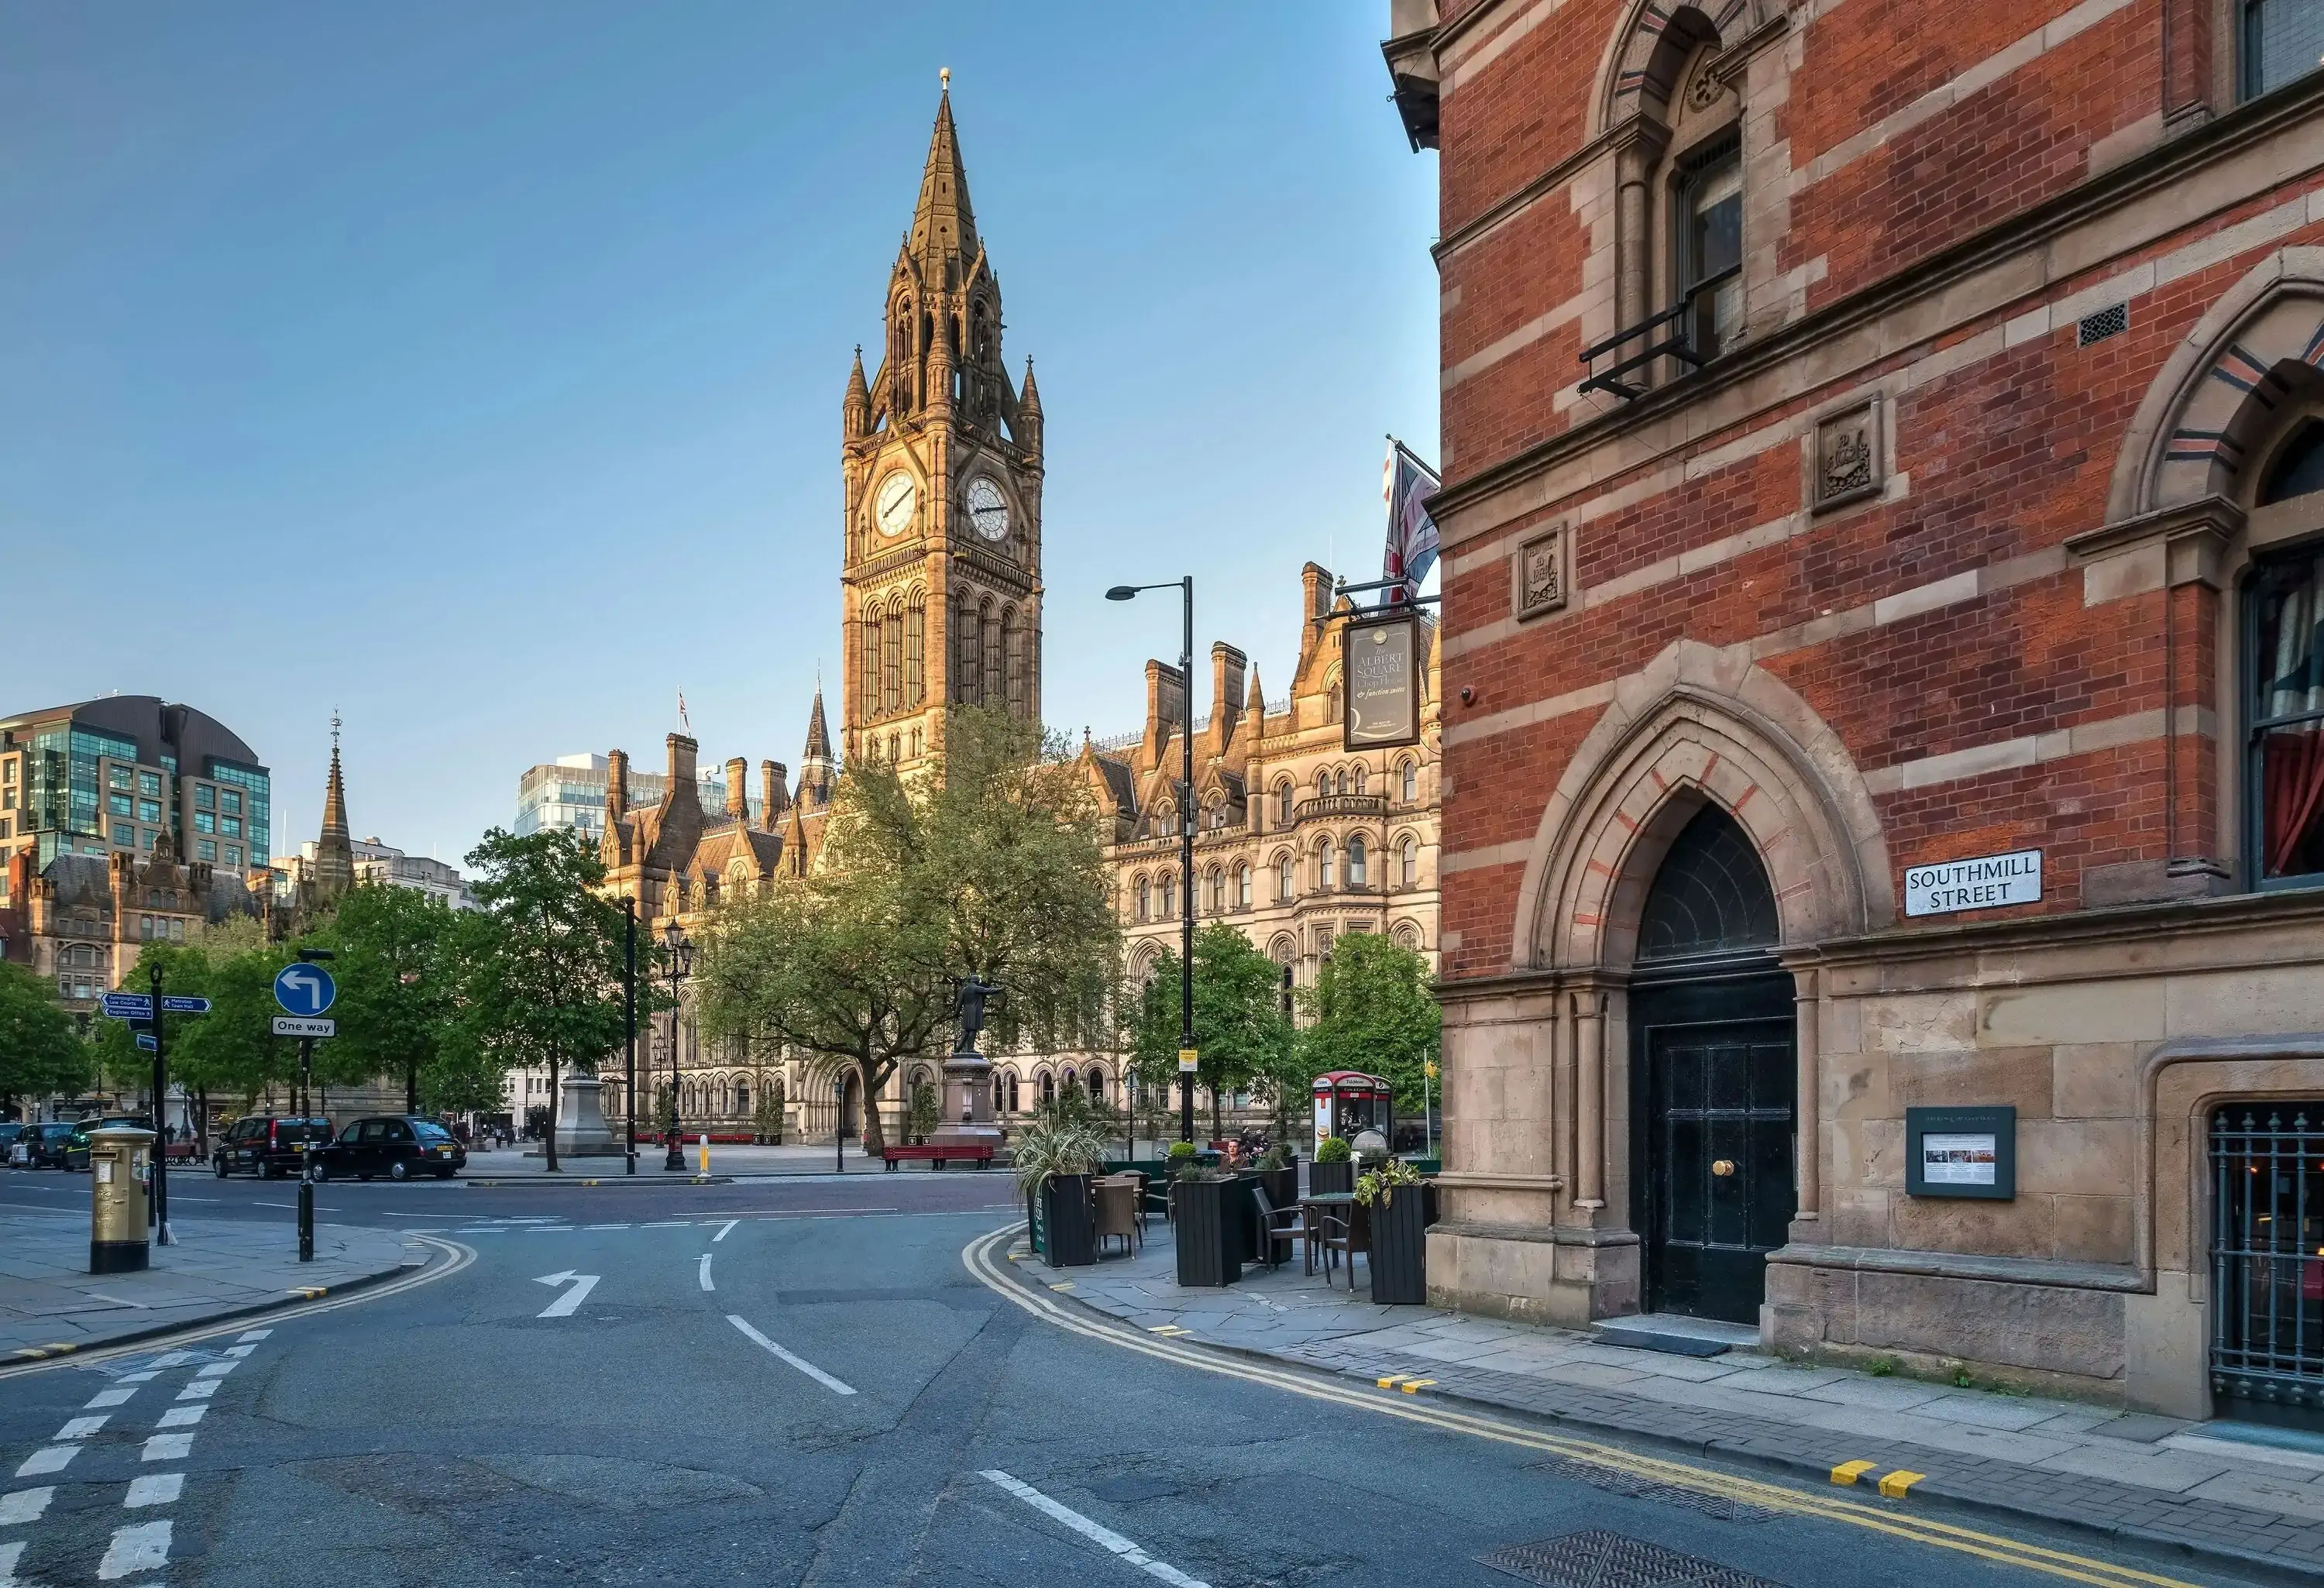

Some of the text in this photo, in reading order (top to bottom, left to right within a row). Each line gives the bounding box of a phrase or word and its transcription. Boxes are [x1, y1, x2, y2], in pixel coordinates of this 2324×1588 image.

[1357, 653, 1404, 667] ALBERT
[1357, 663, 1404, 679] SQUARE
[1365, 688, 1389, 699] function
[1390, 686, 1405, 695] suites
[1910, 857, 2036, 889] SOUTHMILL
[1930, 882, 2012, 909] STREET
[278, 1021, 330, 1033] One way
